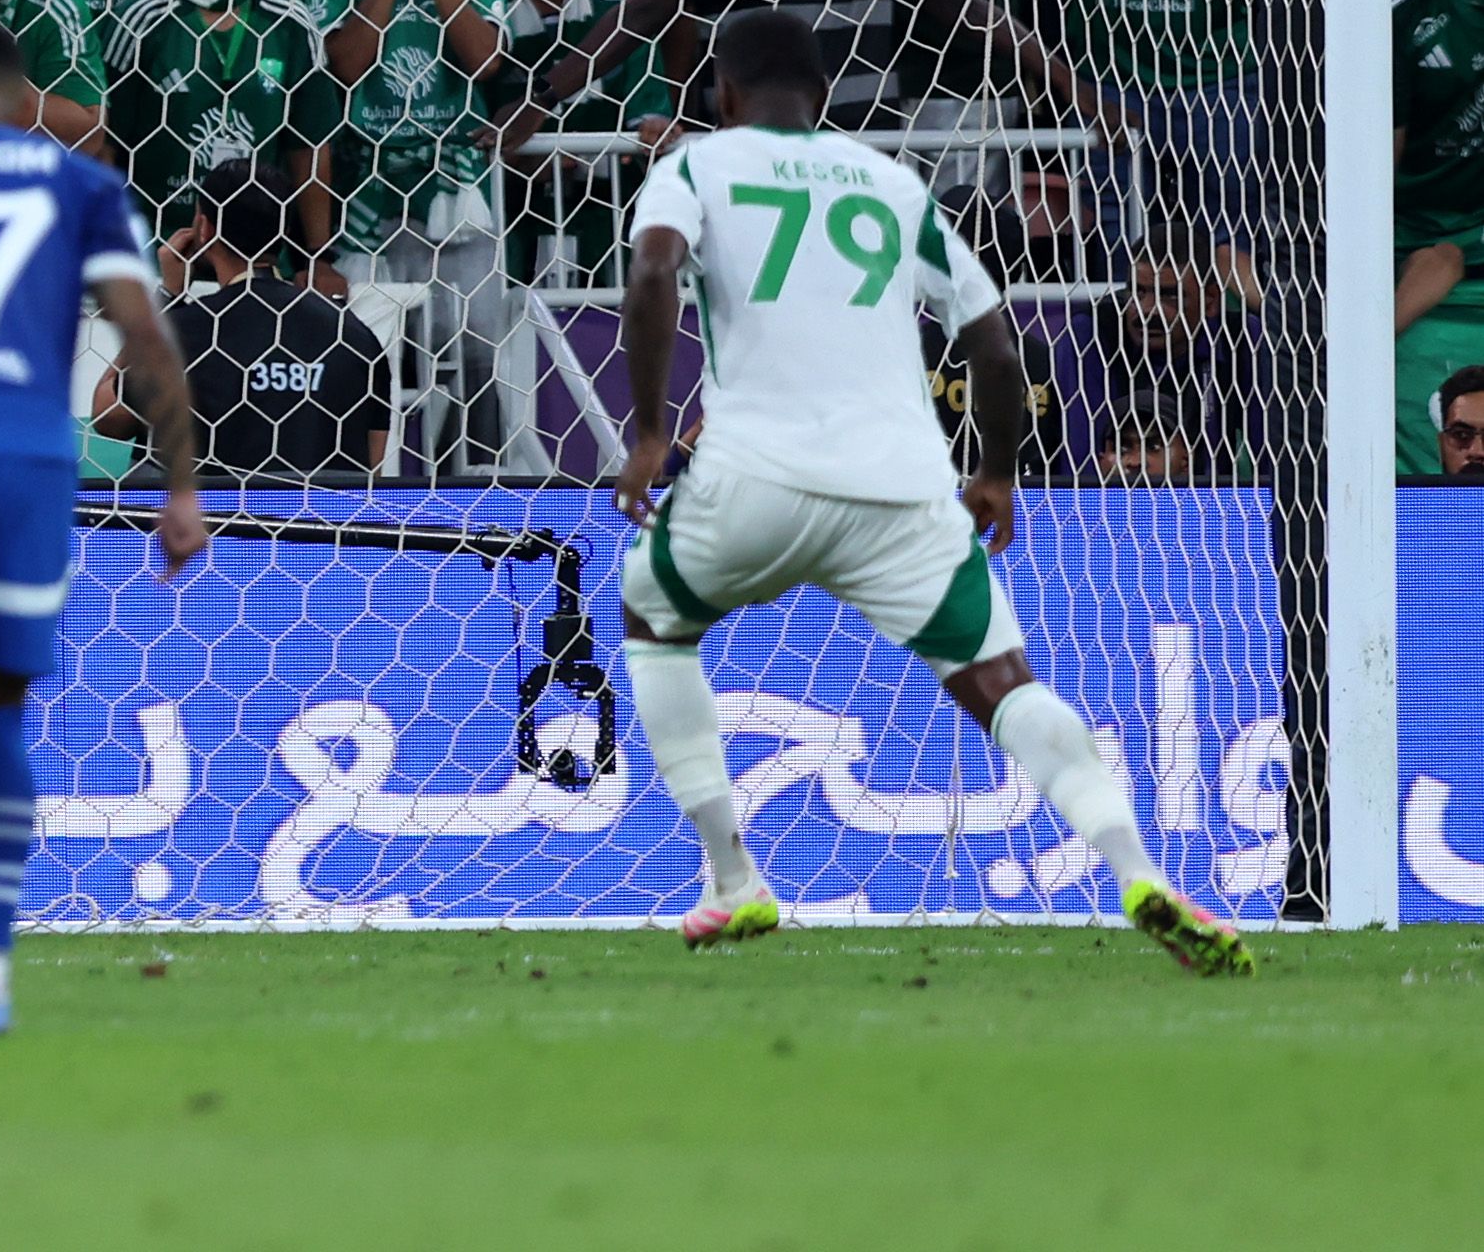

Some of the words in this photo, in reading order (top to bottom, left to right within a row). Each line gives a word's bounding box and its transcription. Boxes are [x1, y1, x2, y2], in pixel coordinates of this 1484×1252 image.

[771, 159, 875, 188] KESSIE
[729, 185, 902, 310] 79
[250, 361, 326, 393] 3587
[926, 368, 1050, 419] Poe
